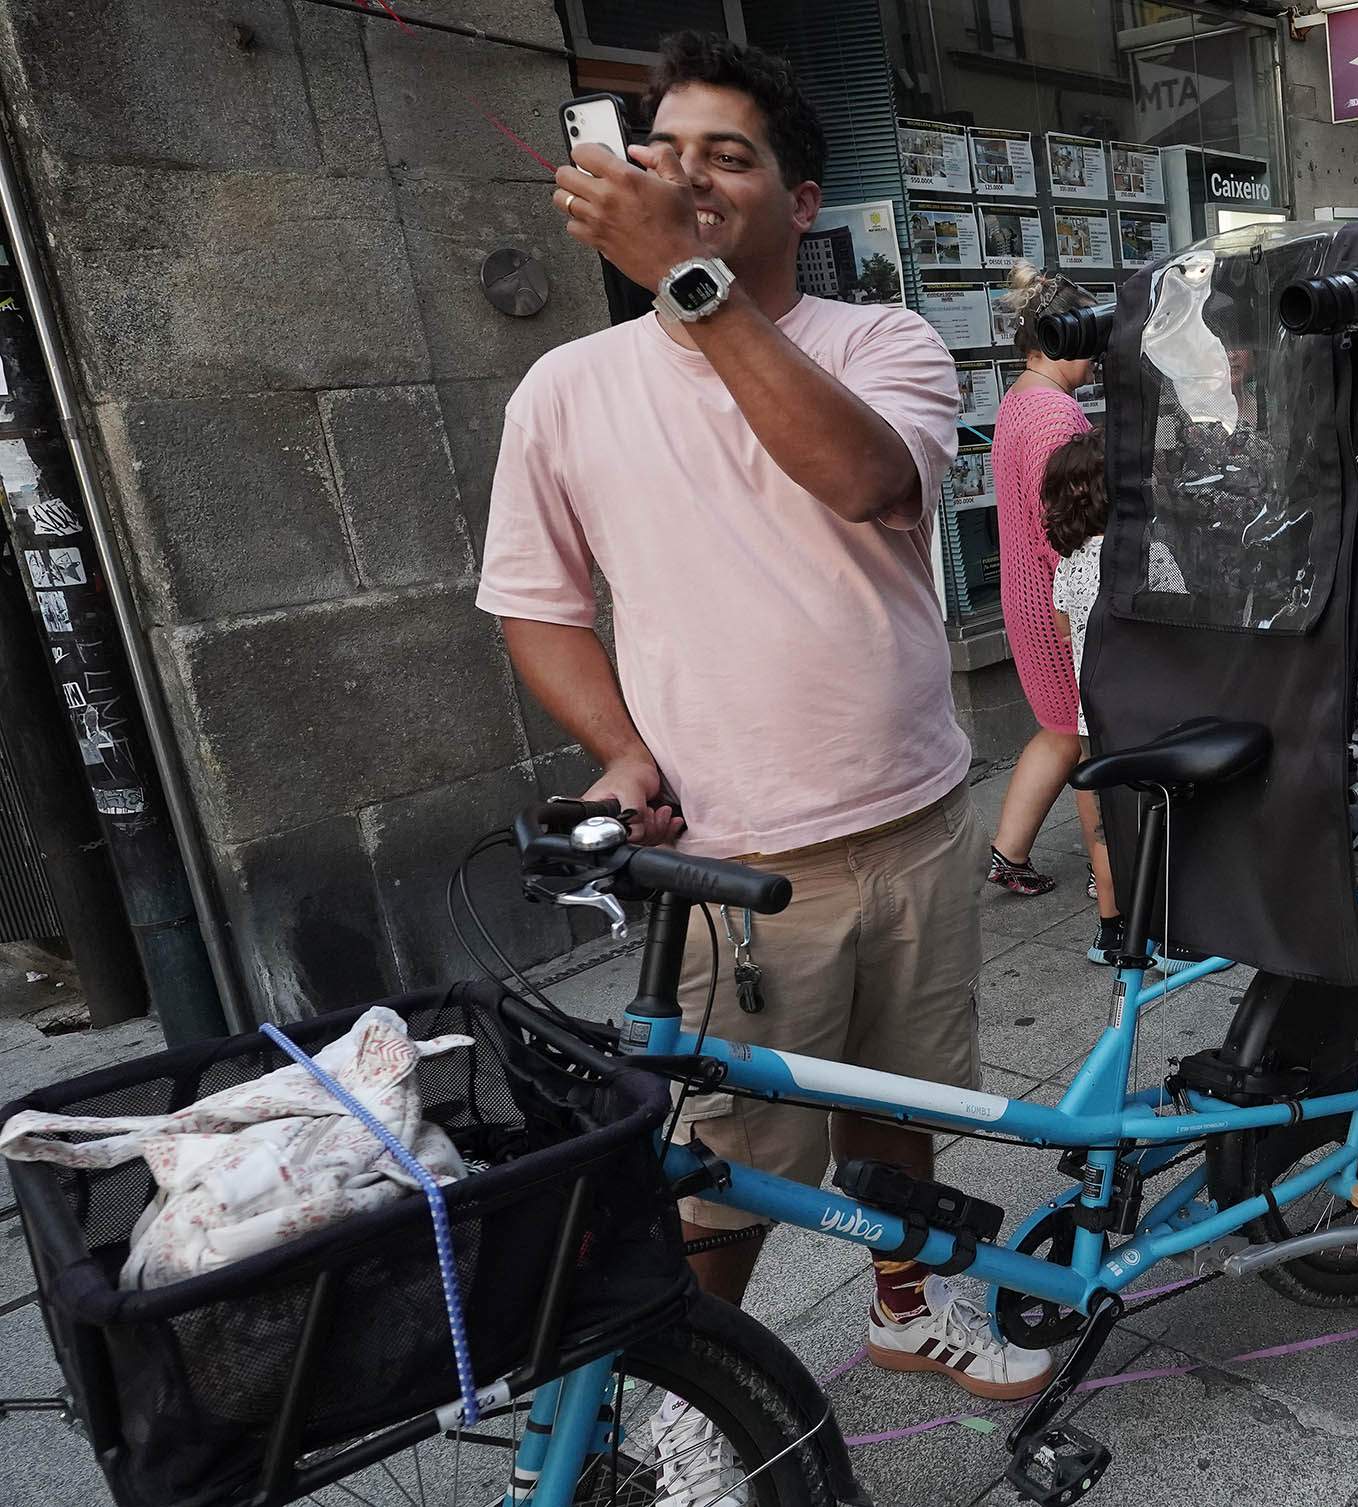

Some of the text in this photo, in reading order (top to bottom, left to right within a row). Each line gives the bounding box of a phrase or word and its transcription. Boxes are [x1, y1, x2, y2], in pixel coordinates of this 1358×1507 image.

[1211, 173, 1270, 200] Caixeiro
[966, 1104, 991, 1117] KOMBI
[818, 1207, 885, 1242] yuba
